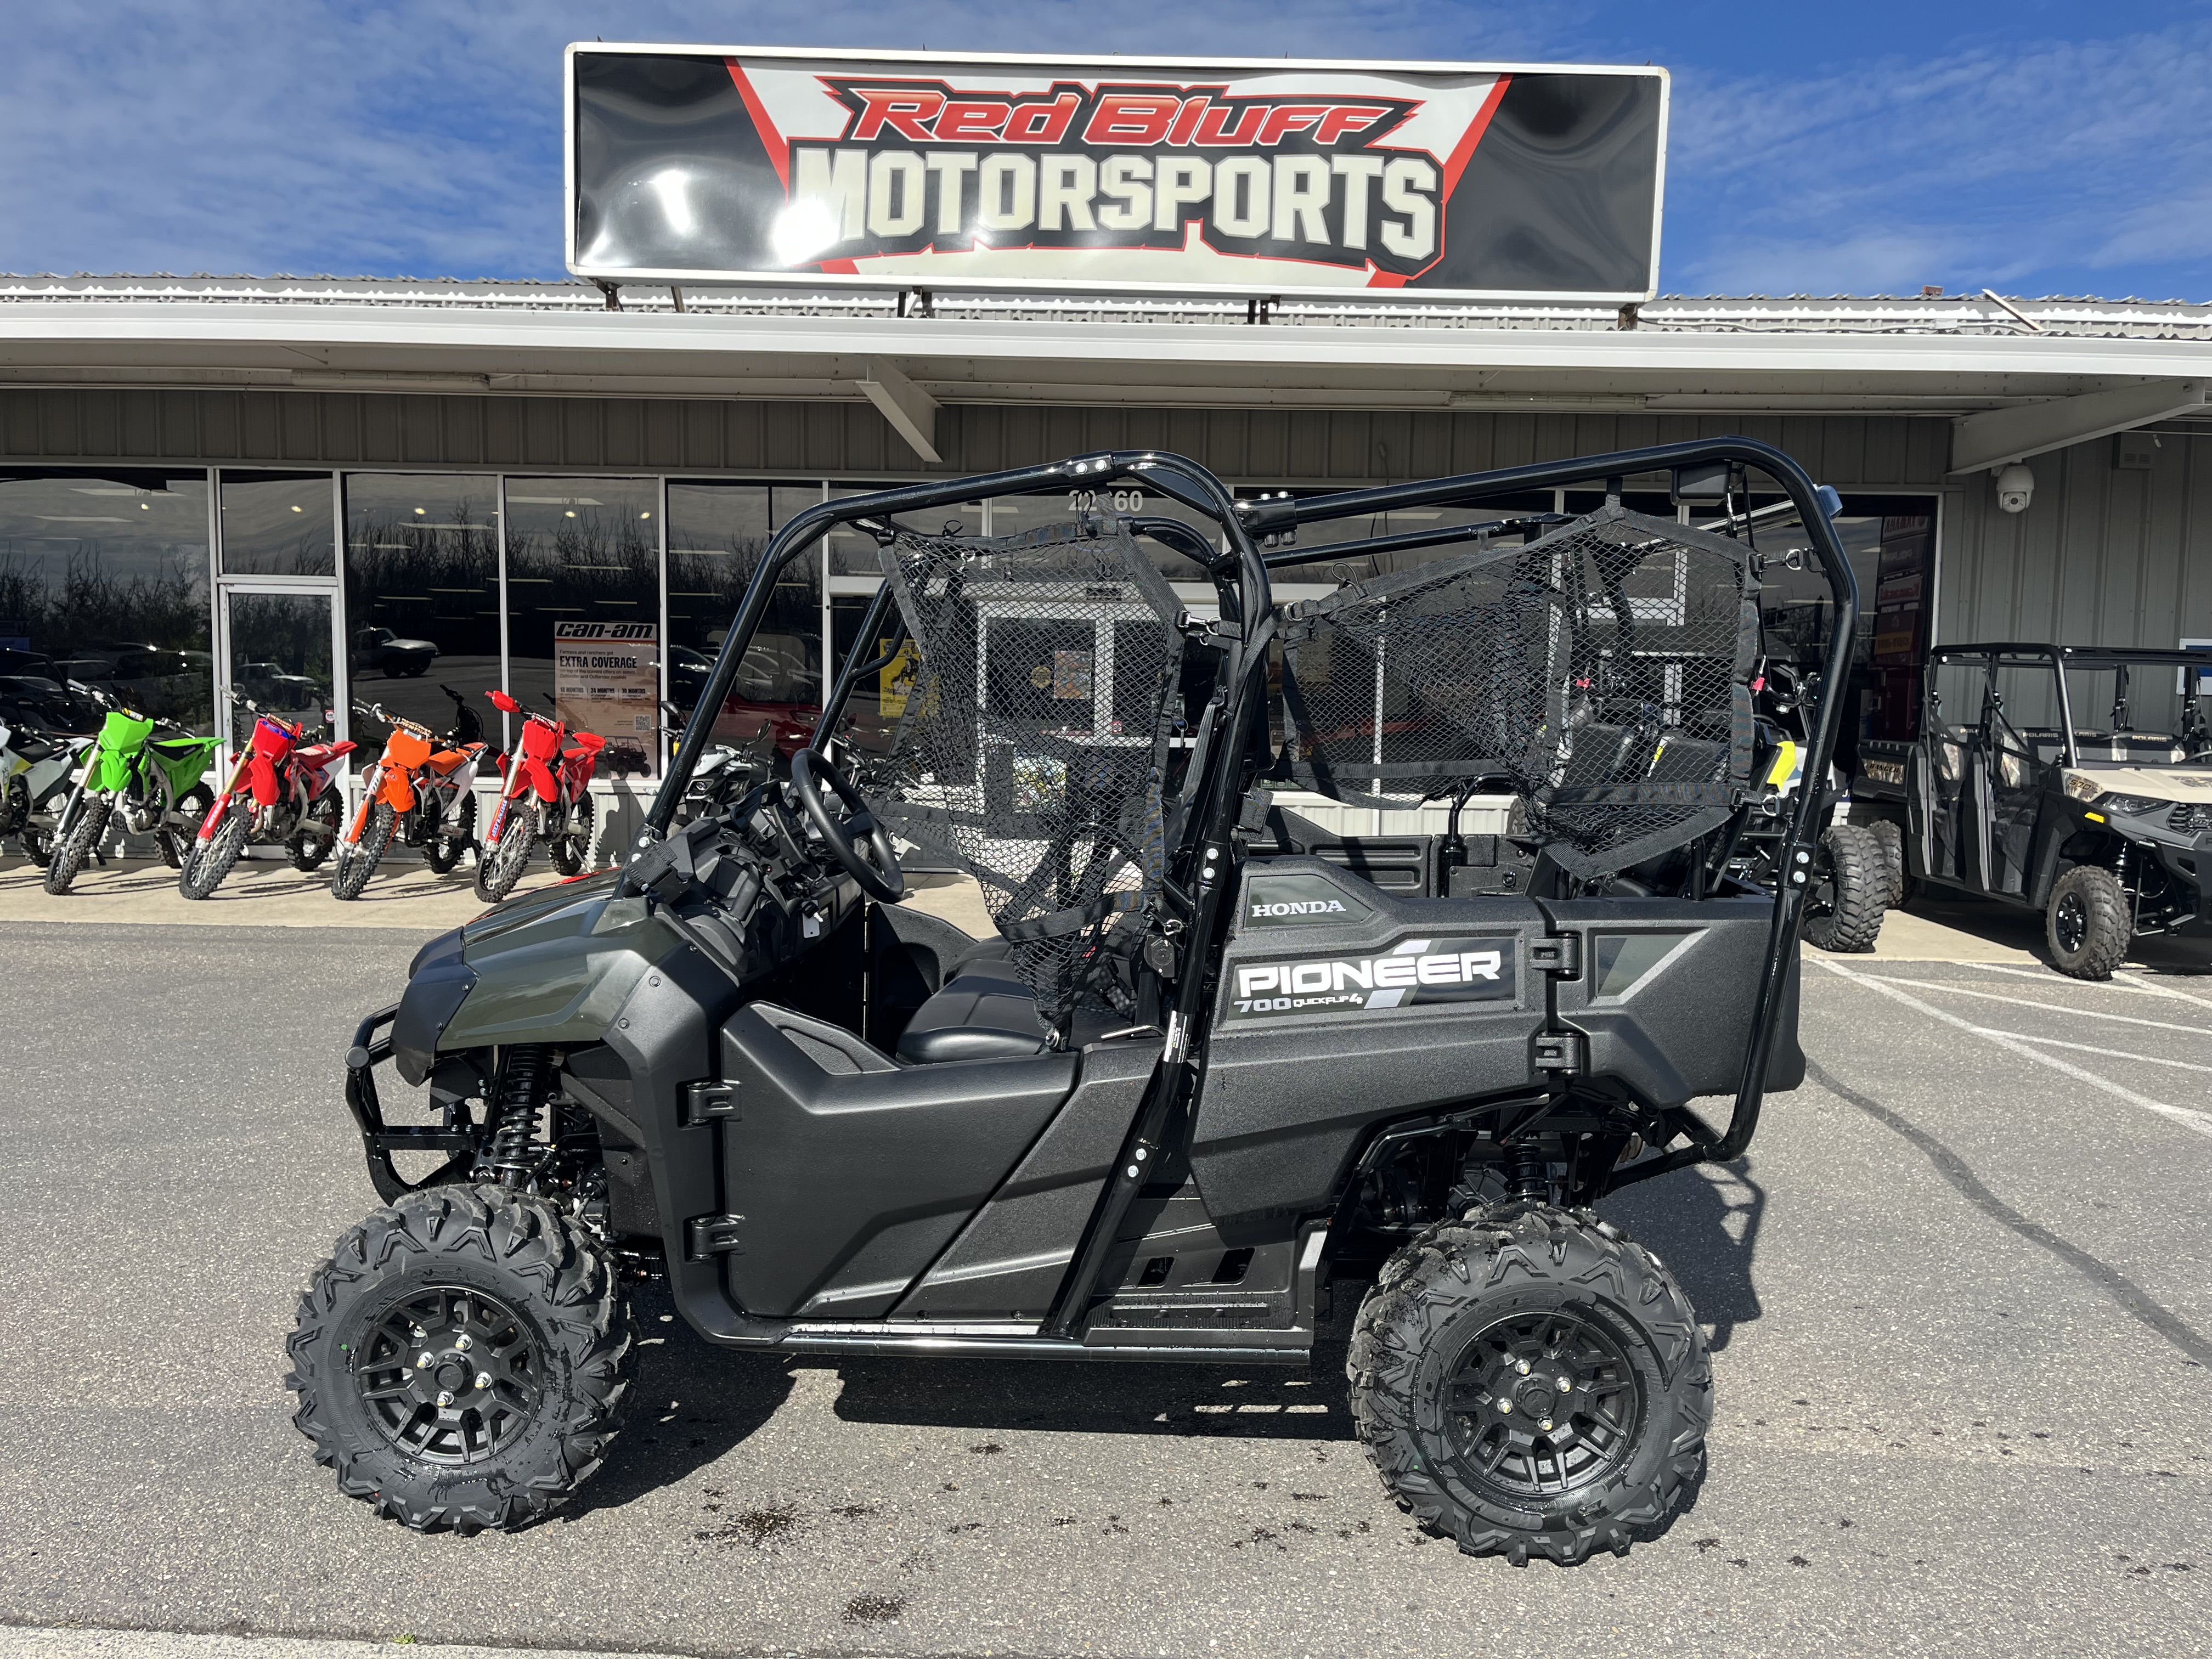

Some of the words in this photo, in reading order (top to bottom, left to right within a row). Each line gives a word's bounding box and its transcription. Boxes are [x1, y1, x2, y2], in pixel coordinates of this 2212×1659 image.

[795, 148, 1437, 261] MOTORSPORTS
[1068, 489, 1143, 512] 2260
[560, 656, 588, 668] EXTRA
[591, 657, 637, 668] COVERAGE
[1870, 763, 1899, 774] RANGER
[2069, 779, 2091, 790] 570
[1251, 900, 1346, 918] HONDA
[1239, 950, 1502, 998] PIONEER
[1233, 997, 1292, 1013] 700
